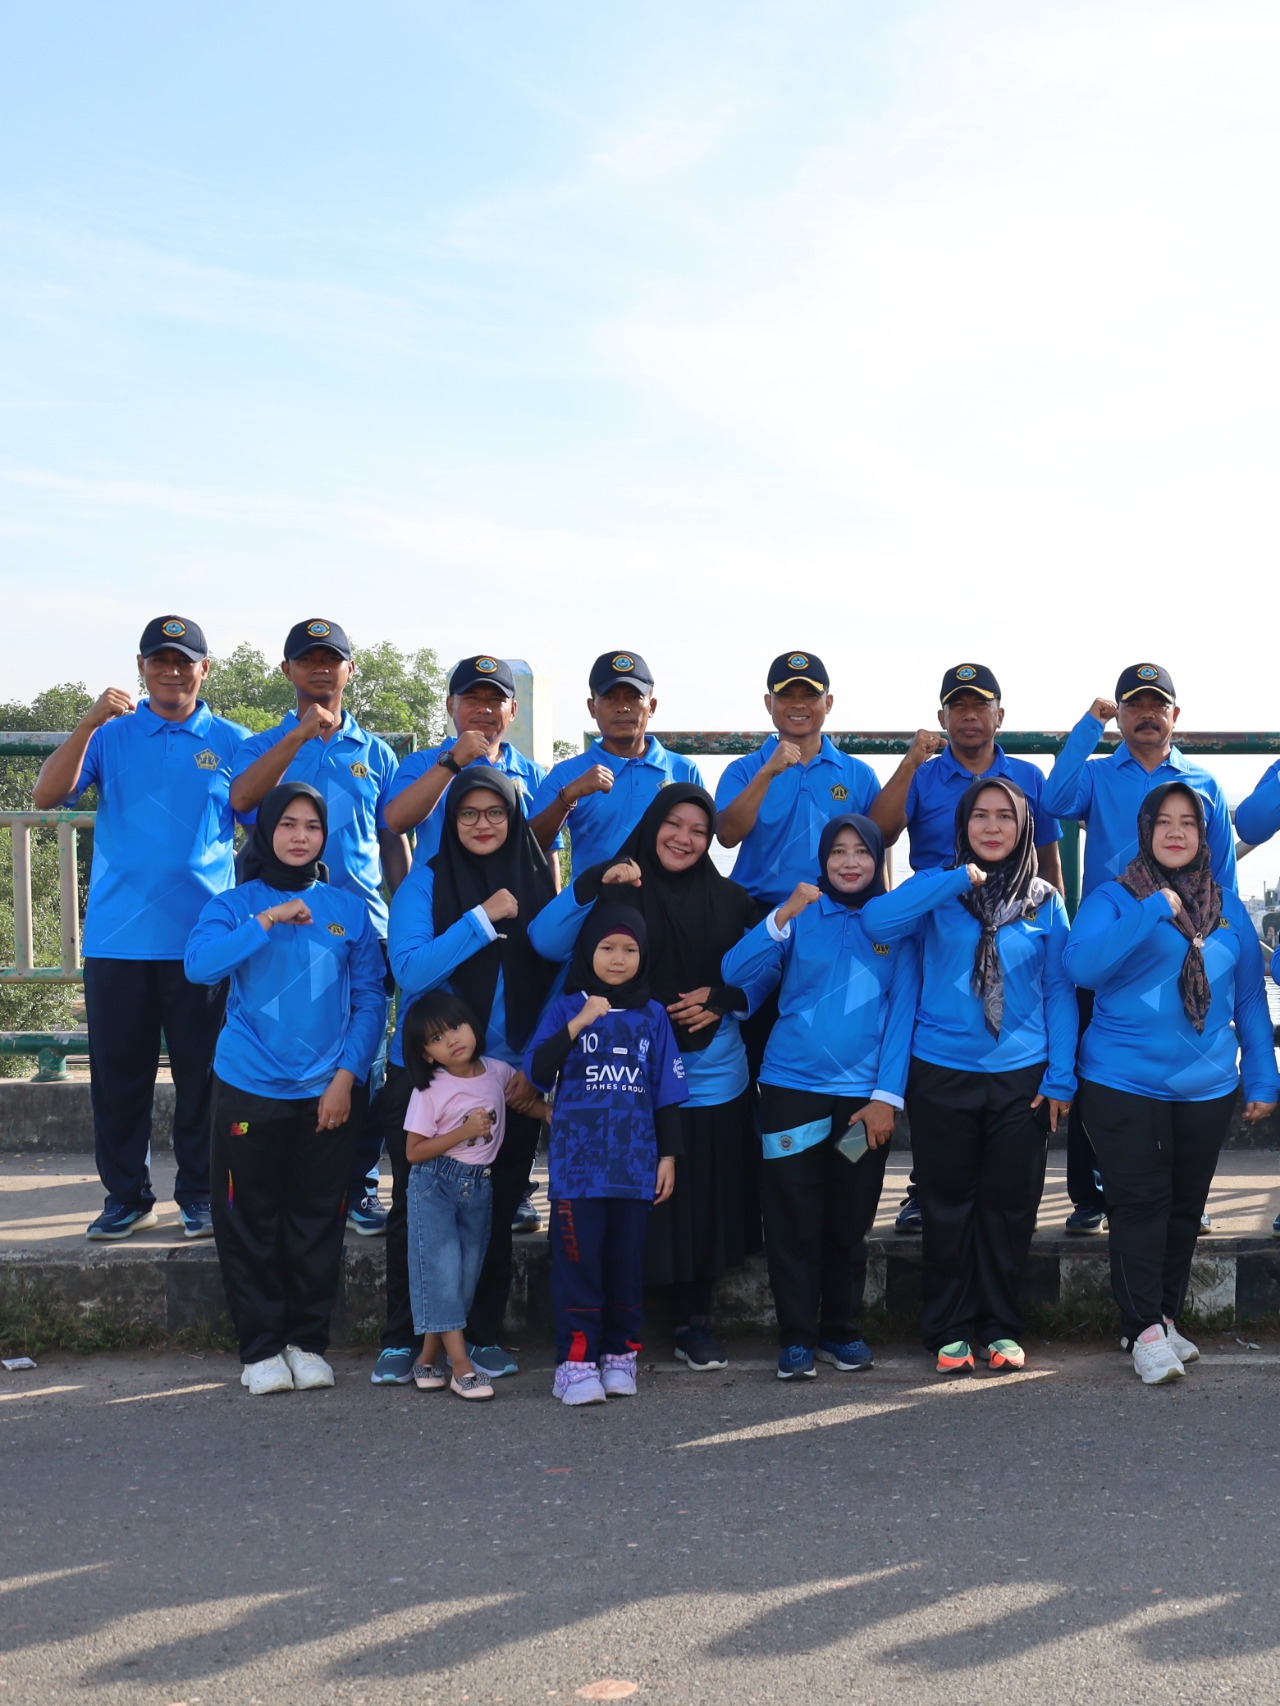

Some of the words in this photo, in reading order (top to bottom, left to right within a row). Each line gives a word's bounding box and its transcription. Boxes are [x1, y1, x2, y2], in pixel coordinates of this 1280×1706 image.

[581, 1033, 599, 1054] 10
[585, 1064, 642, 1083] SAVV
[621, 1084, 646, 1093] GROU
